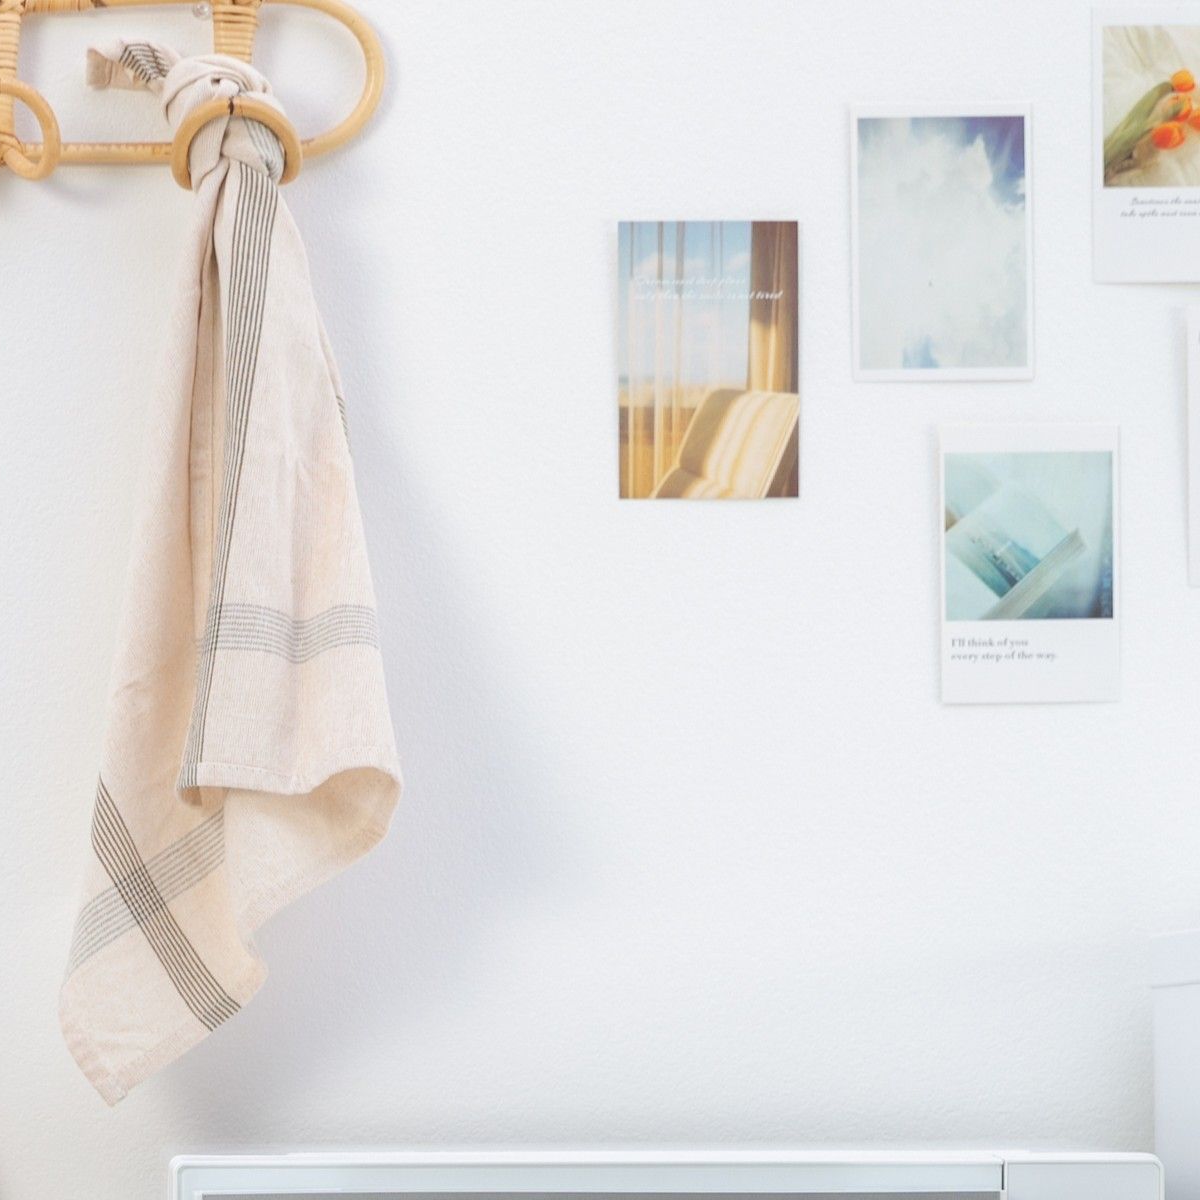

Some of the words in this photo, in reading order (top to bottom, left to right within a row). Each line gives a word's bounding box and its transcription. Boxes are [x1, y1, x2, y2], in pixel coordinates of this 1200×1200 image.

[967, 637, 994, 647] think
[997, 637, 1008, 647] of
[1009, 639, 1028, 649] you
[950, 653, 978, 663] every
[981, 651, 1002, 662] step
[1004, 650, 1015, 659] of
[1017, 650, 1033, 659] the
